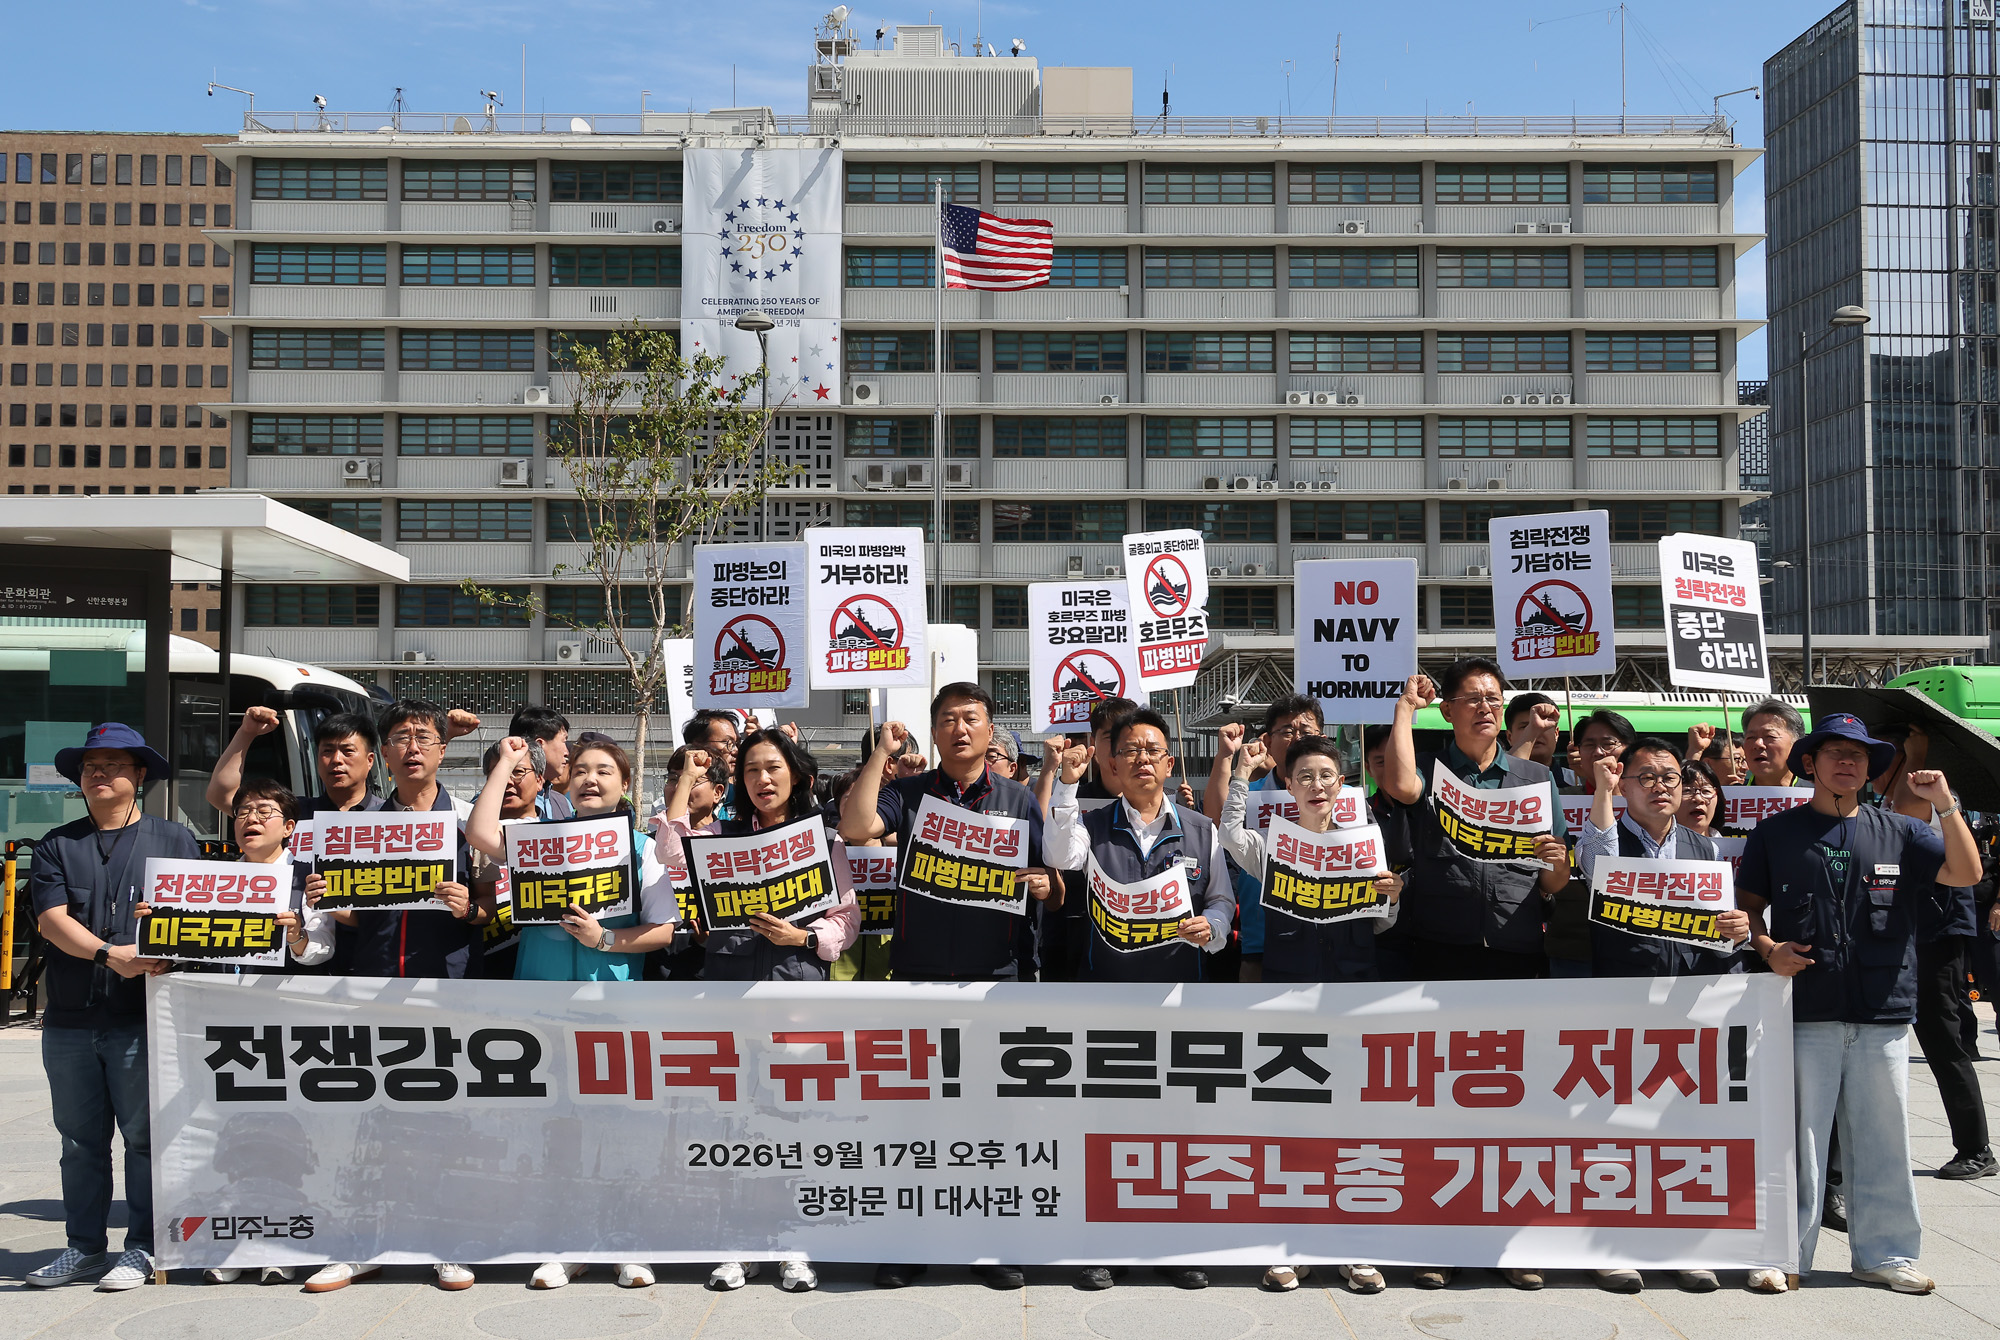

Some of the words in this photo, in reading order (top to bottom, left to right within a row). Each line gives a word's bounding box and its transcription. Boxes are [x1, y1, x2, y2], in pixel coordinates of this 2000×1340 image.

[737, 223, 787, 233] Freedom
[737, 234, 787, 259] 250
[701, 297, 760, 306] CELEBRATING
[761, 297, 778, 305] 250
[779, 297, 807, 305] YEARS
[808, 297, 821, 305] OF
[763, 308, 805, 316] FREEDOM
[719, 319, 734, 328] 미국
[785, 319, 801, 328] 기념
[1129, 542, 1163, 556] 굴종외교
[1163, 538, 1200, 553] 중단하라!
[1510, 525, 1590, 549] 침략전쟁
[820, 545, 856, 557] 미국의
[858, 545, 906, 557] 파병압박
[1511, 551, 1591, 573] 가담하는
[713, 560, 787, 582] 파병논의
[820, 564, 909, 585] 거부하라!
[1682, 551, 1735, 578] 미국은
[0, 587, 51, 600] 문화회관
[711, 586, 790, 608] 중단하라!
[1061, 589, 1112, 607] 미국은
[1334, 581, 1379, 605] NO
[1675, 577, 1746, 607] 침략전쟁
[1048, 610, 1098, 623] 호르무즈
[1101, 609, 1126, 622] 파병
[1677, 612, 1726, 640] 중단
[1048, 625, 1128, 645] 강요말라!
[1139, 615, 1204, 643] 호르무즈
[1313, 618, 1400, 642] NAVY
[1515, 626, 1554, 636] 호르무즈
[829, 639, 868, 649] 호르무즈
[1516, 633, 1595, 658] 파병반대
[1698, 642, 1758, 669] 하라!
[713, 660, 749, 670] 호르무즈
[830, 648, 906, 671] 파병반대
[1342, 654, 1370, 672] TO
[714, 670, 787, 693] 파병반대
[1052, 691, 1089, 701] 호르무즈
[1053, 701, 1097, 722] 파병
[1441, 779, 1542, 825] 전쟁강요
[325, 822, 444, 856] 침략전쟁
[921, 812, 1020, 858] 침략전쟁
[517, 830, 619, 868] 전쟁강요
[707, 829, 816, 880] 침략전쟁
[1277, 833, 1378, 872] 침략전쟁
[322, 864, 444, 898] 파병반대
[910, 851, 1017, 898] 파병반대
[1606, 870, 1723, 901] 침략전쟁
[154, 874, 278, 904] 전쟁강요
[519, 870, 622, 910] 미국규탄
[714, 866, 824, 918] 파병반대
[1093, 869, 1183, 914] 전쟁강요
[1271, 871, 1378, 910] 파병반대
[148, 916, 276, 948] 미국규탄
[1600, 901, 1721, 939] 파병반대
[204, 1025, 547, 1102] 전쟁강요
[575, 1031, 740, 1101] 미국
[769, 1028, 961, 1102] 규탄!
[996, 1026, 1333, 1103] 호르무즈
[1360, 1029, 1526, 1108] 파병
[1552, 1027, 1748, 1105] 저지!
[687, 1142, 803, 1170] 2026년
[813, 1142, 863, 1170] 9월
[873, 1140, 937, 1170] 17일
[947, 1140, 1007, 1170] 오후
[1015, 1140, 1058, 1170] 1시
[1111, 1141, 1405, 1213] 민주노총
[1431, 1144, 1730, 1216] 기자회견
[798, 1185, 888, 1217] 광화문
[897, 1185, 923, 1217] 미
[934, 1185, 1023, 1218] 대사관
[1031, 1186, 1061, 1217] 앞
[211, 1215, 315, 1241] 민주노총
